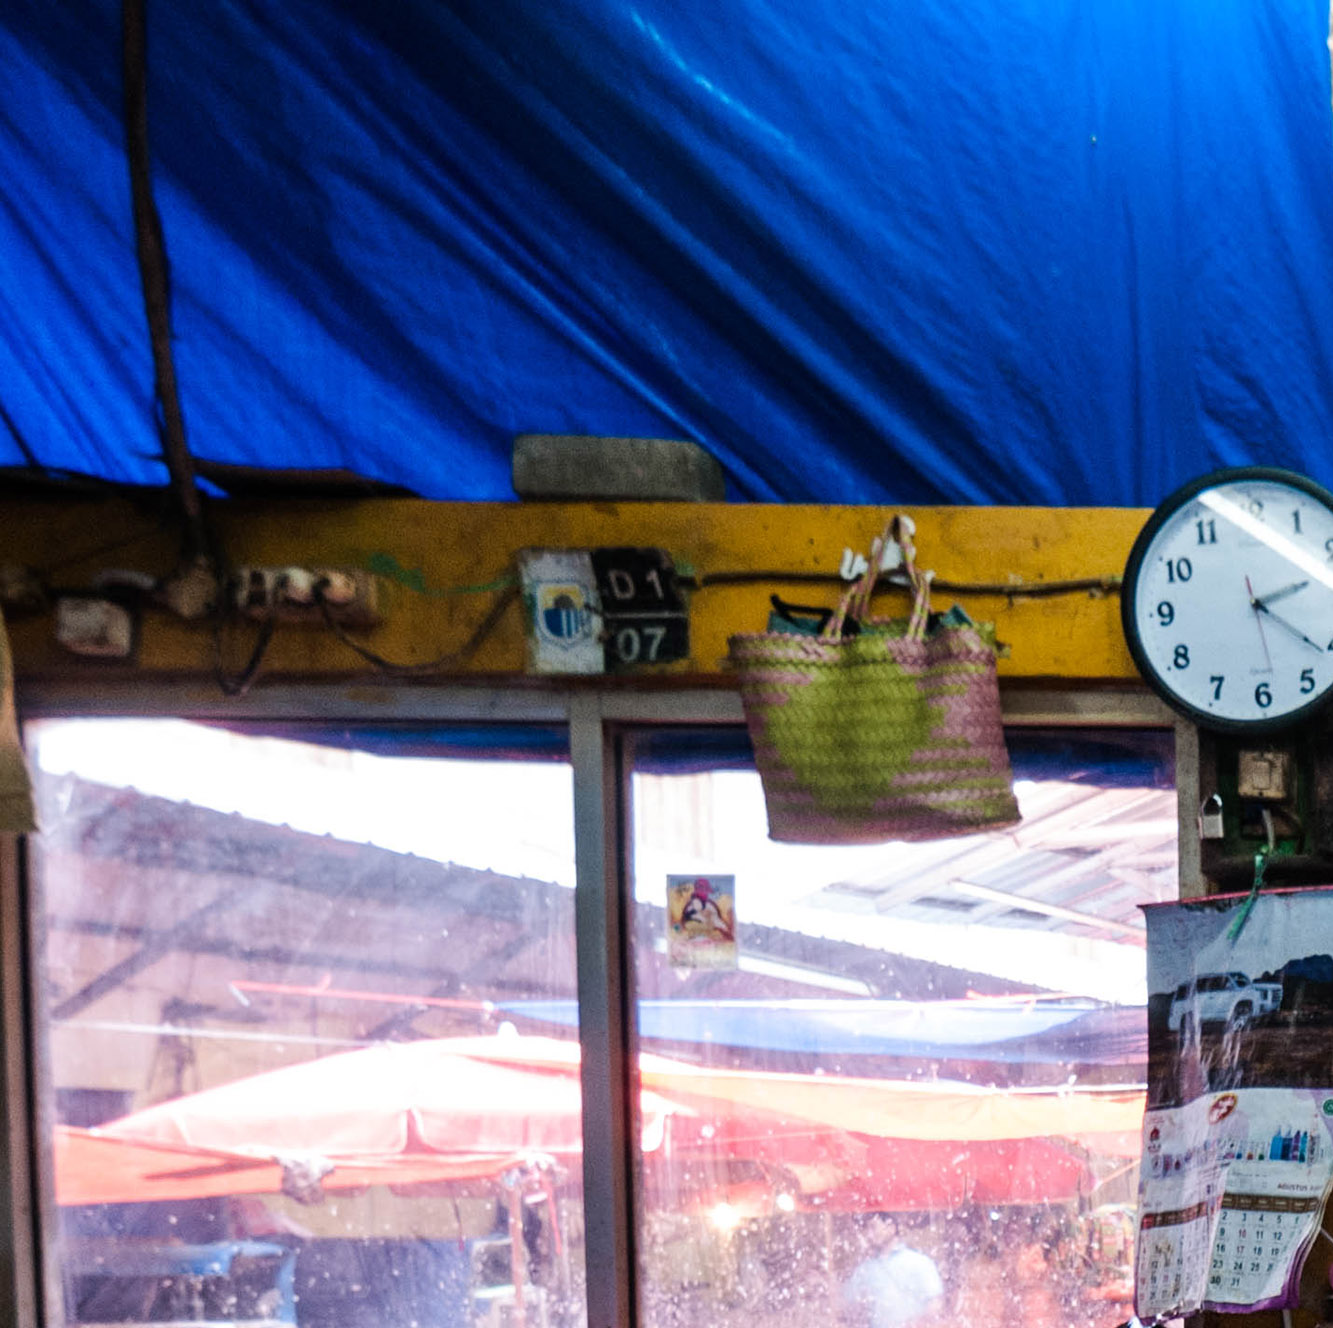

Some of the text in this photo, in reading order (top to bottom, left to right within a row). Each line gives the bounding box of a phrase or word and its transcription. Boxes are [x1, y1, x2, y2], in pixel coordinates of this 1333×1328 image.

[1196, 518, 1217, 545] 11
[1291, 510, 1302, 534] 1
[1166, 557, 1193, 583] 10
[1157, 601, 1175, 627] 9
[617, 626, 667, 662] 07
[1173, 644, 1190, 669] 8
[1210, 676, 1225, 700] 7
[1300, 668, 1315, 694] 5
[1255, 683, 1272, 708] 6
[1277, 1183, 1309, 1191] AGUSTUS
[1222, 1212, 1228, 1220] 2
[1242, 1213, 1247, 1221] 3
[1259, 1214, 1264, 1222] 4
[1277, 1215, 1282, 1223] 5
[1220, 1227, 1282, 1240] 9 10 11 12
[1216, 1244, 1279, 1256] 16 17 18 19
[1213, 1260, 1223, 1269] 23
[1234, 1262, 1243, 1271] 24
[1251, 1263, 1260, 1272] 25
[1210, 1276, 1240, 1286] 30 31
